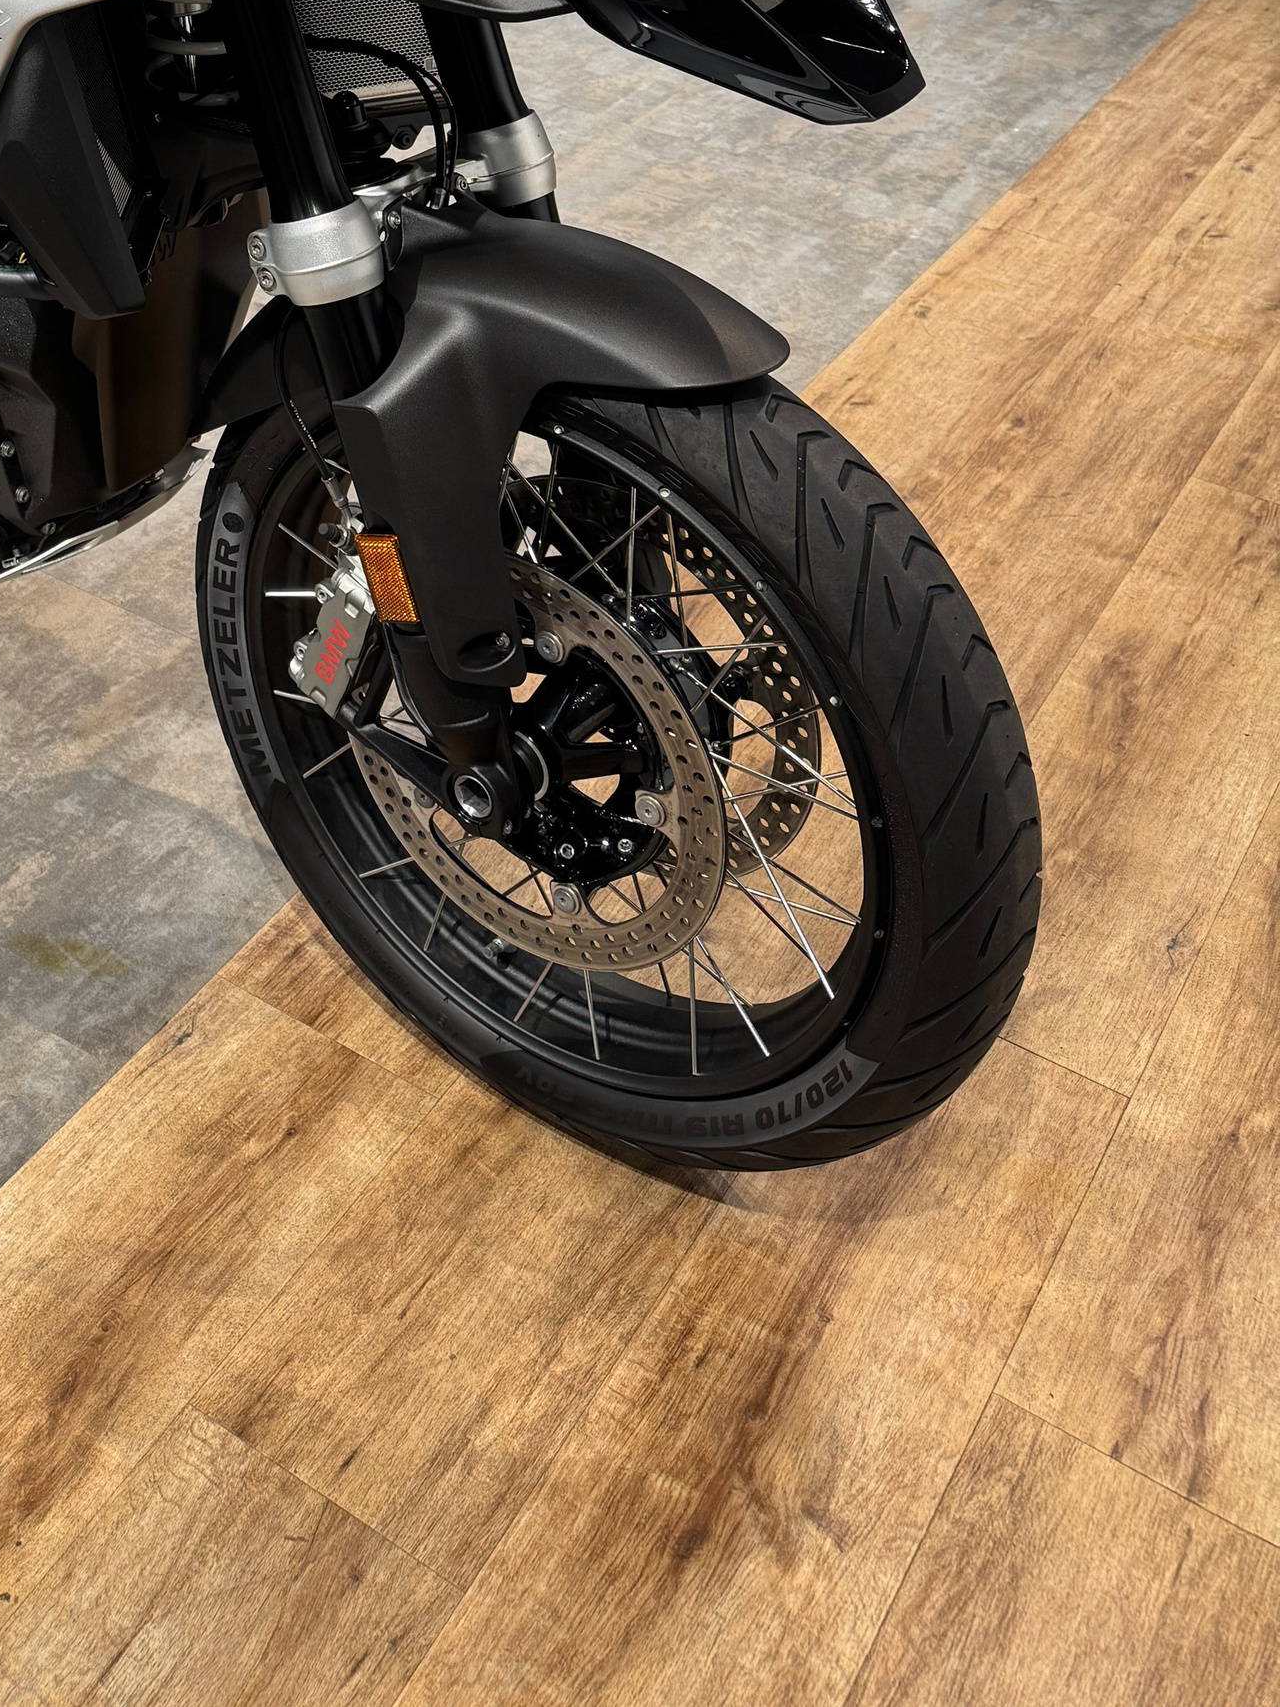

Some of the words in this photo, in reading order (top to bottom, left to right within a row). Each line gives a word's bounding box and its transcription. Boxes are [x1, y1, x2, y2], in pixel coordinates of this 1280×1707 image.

[212, 537, 272, 778] METZELER
[314, 618, 351, 686] BMW
[684, 1113, 745, 1138] R19
[755, 1058, 855, 1130] 120/70
